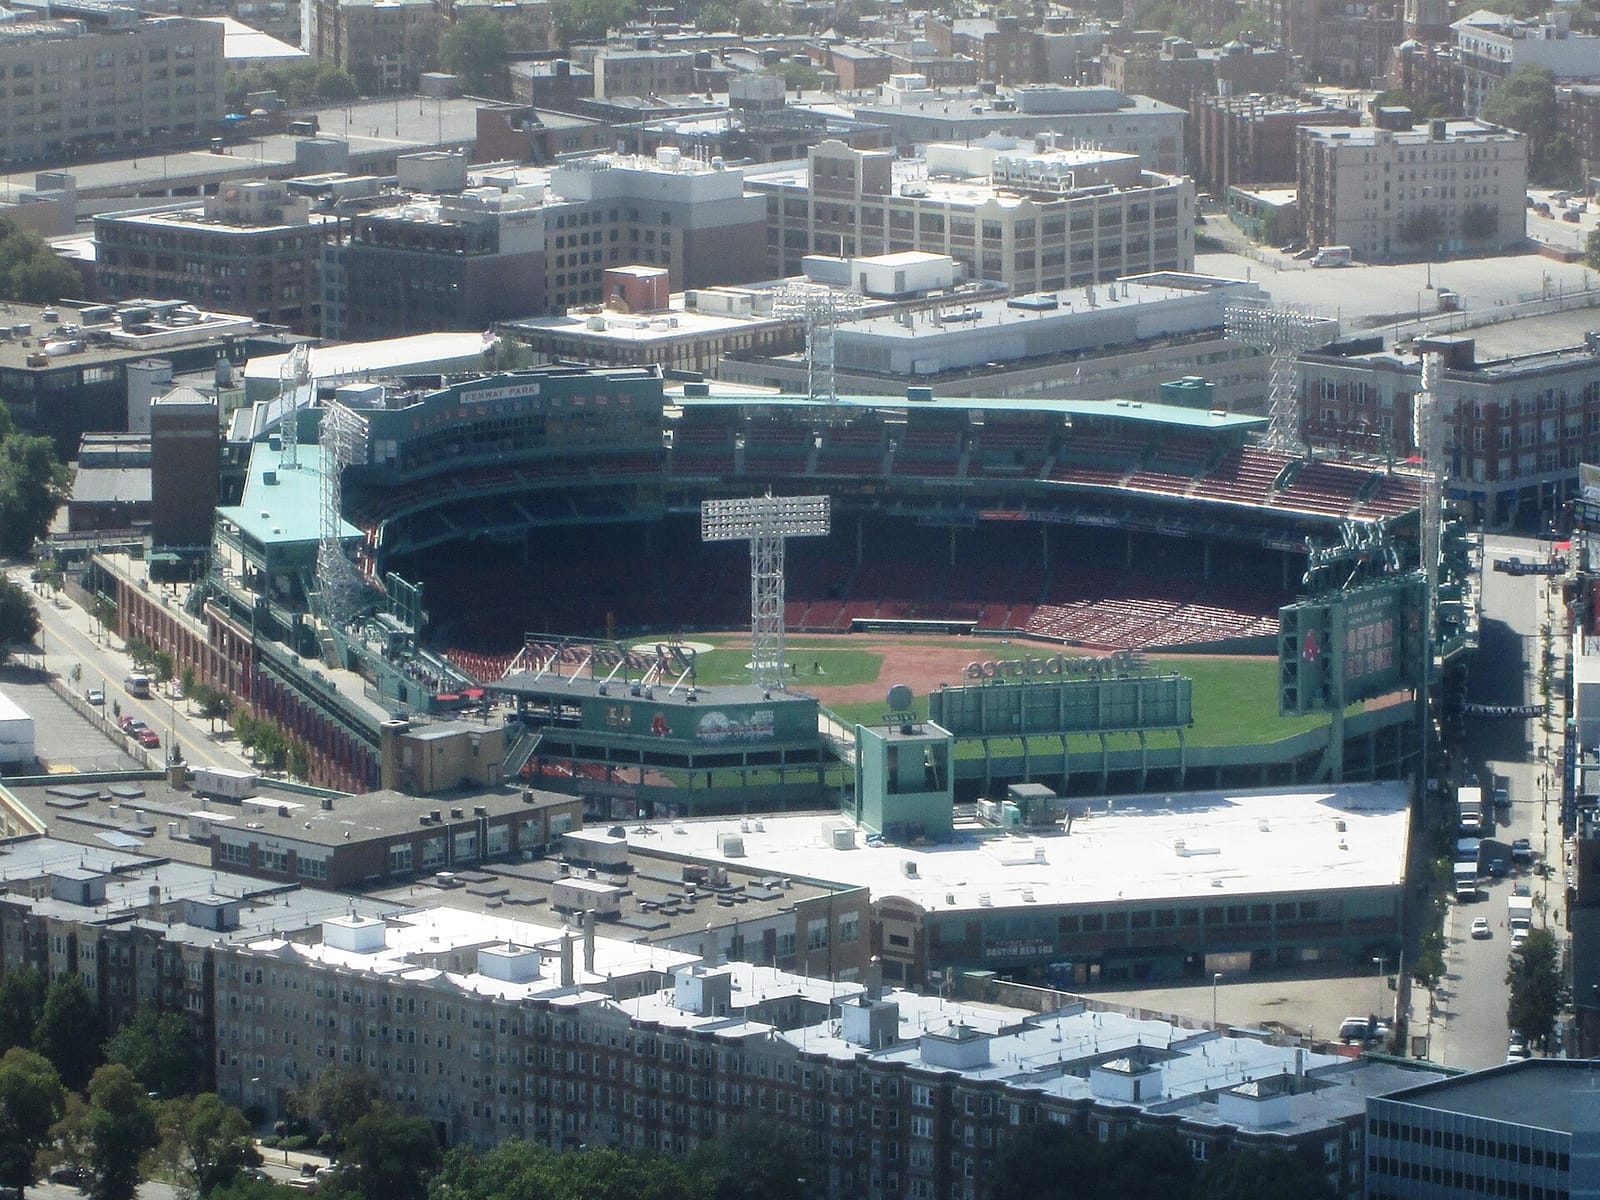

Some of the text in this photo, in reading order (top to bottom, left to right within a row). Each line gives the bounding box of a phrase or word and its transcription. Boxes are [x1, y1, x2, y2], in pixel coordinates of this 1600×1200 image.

[463, 386, 535, 401] FENWAY PARK
[1344, 619, 1393, 653] OSTON
[985, 945, 1054, 956] BOSTON RED SOX
